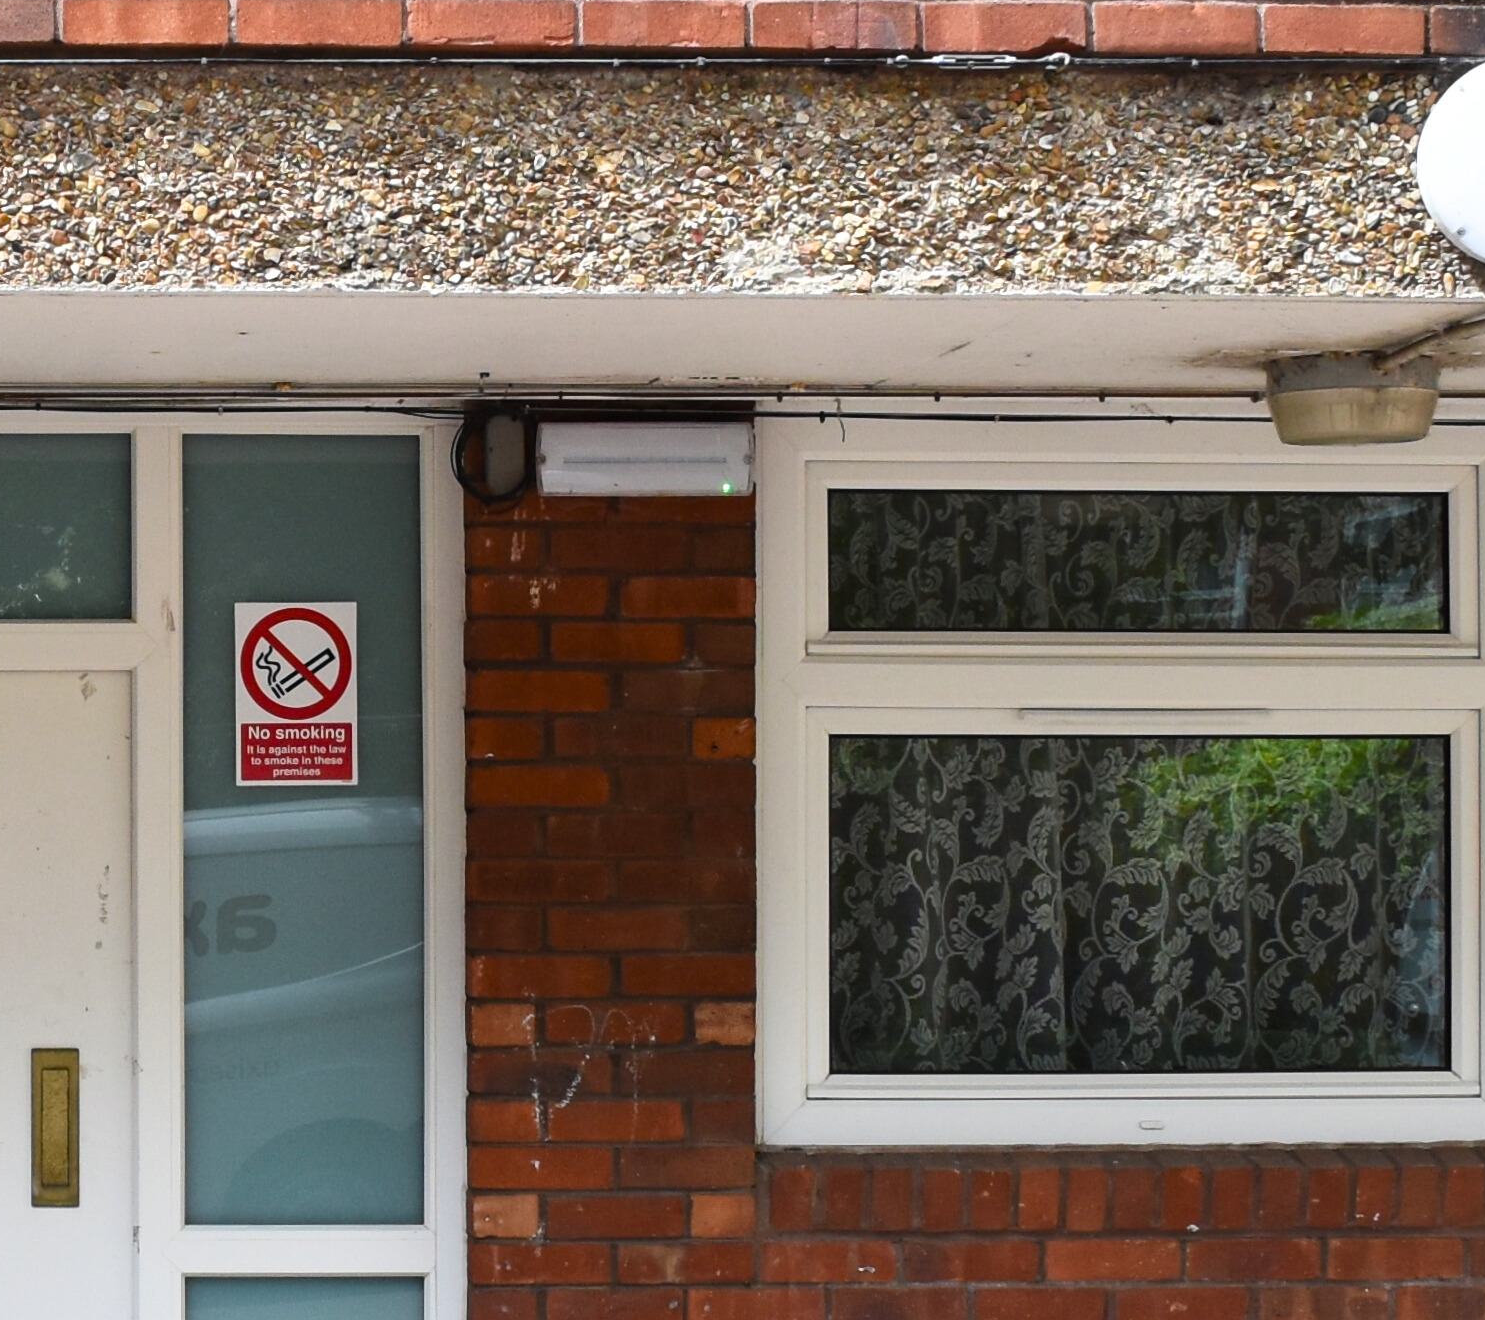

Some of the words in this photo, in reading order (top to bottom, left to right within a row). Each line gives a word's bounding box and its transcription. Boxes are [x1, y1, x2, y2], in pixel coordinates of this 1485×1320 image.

[248, 725, 271, 740] No
[275, 725, 345, 743] smoking
[246, 745, 254, 754] It
[256, 745, 266, 754] is
[268, 745, 307, 756] against
[309, 745, 327, 754] the
[329, 745, 347, 754] law
[250, 756, 262, 765] to
[264, 756, 299, 765] smoke
[301, 756, 312, 765] in
[314, 756, 343, 765] these
[272, 767, 321, 778] premises
